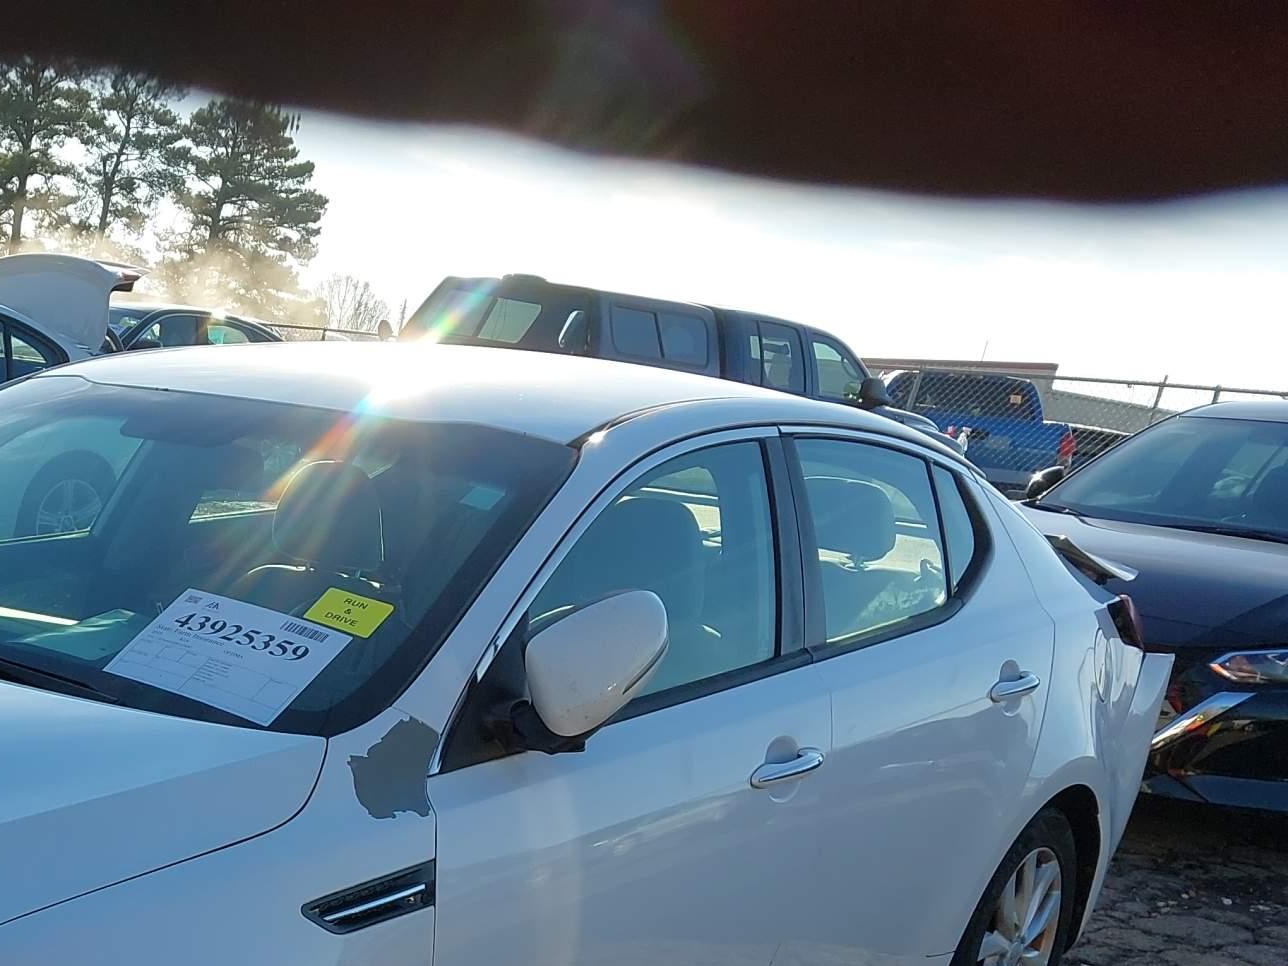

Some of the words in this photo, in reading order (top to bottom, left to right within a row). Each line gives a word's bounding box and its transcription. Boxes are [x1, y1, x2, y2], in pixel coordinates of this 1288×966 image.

[343, 598, 369, 610] RUN
[324, 611, 359, 627] DRIVE
[174, 612, 310, 661] 43925359
